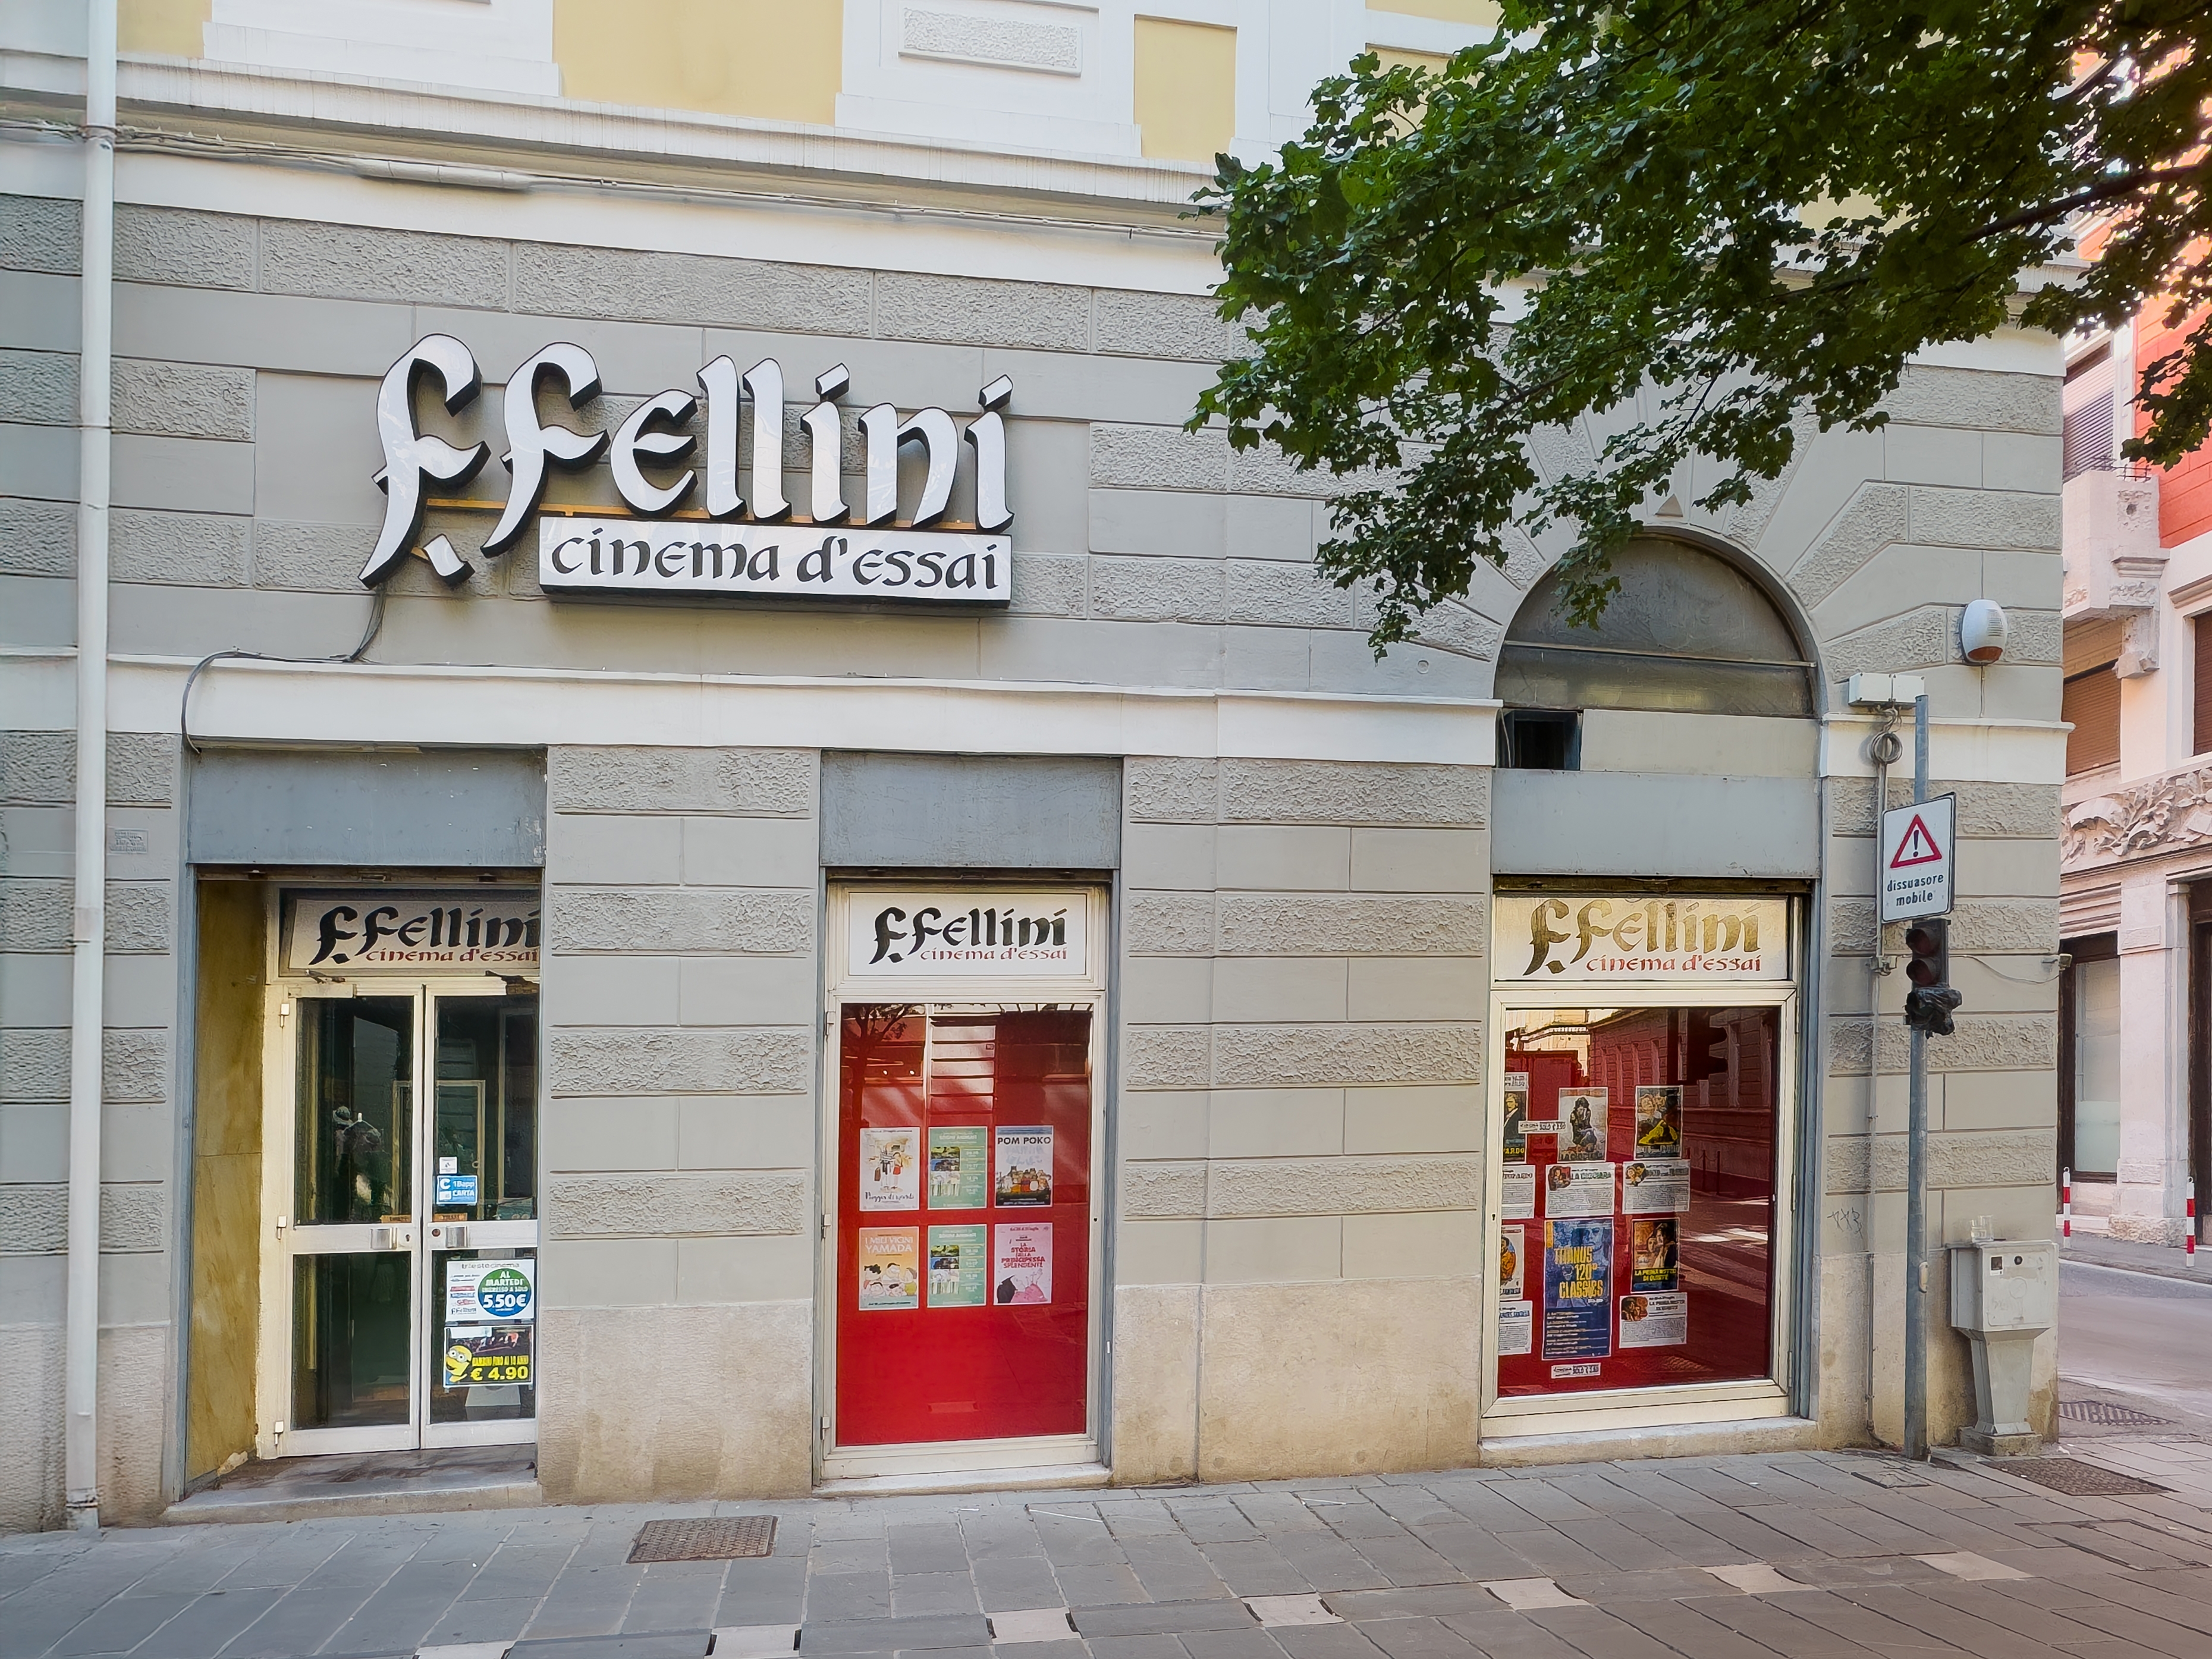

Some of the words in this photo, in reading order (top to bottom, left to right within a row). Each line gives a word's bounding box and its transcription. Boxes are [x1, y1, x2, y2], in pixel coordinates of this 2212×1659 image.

[551, 528, 779, 582] cinema
[796, 535, 1000, 589] d'essai
[1887, 874, 1944, 892] dissuasore
[1896, 890, 1934, 907] mobile
[366, 948, 453, 962] cinema
[920, 947, 995, 960] cinema
[1000, 947, 1067, 960] d'essai
[1586, 954, 1675, 972] cinema
[1682, 954, 1761, 972] d'essai
[1023, 1136, 1051, 1145] POKO
[865, 1244, 912, 1253] YAMADA
[470, 1368, 483, 1381] €
[488, 1366, 529, 1380] 4.90
